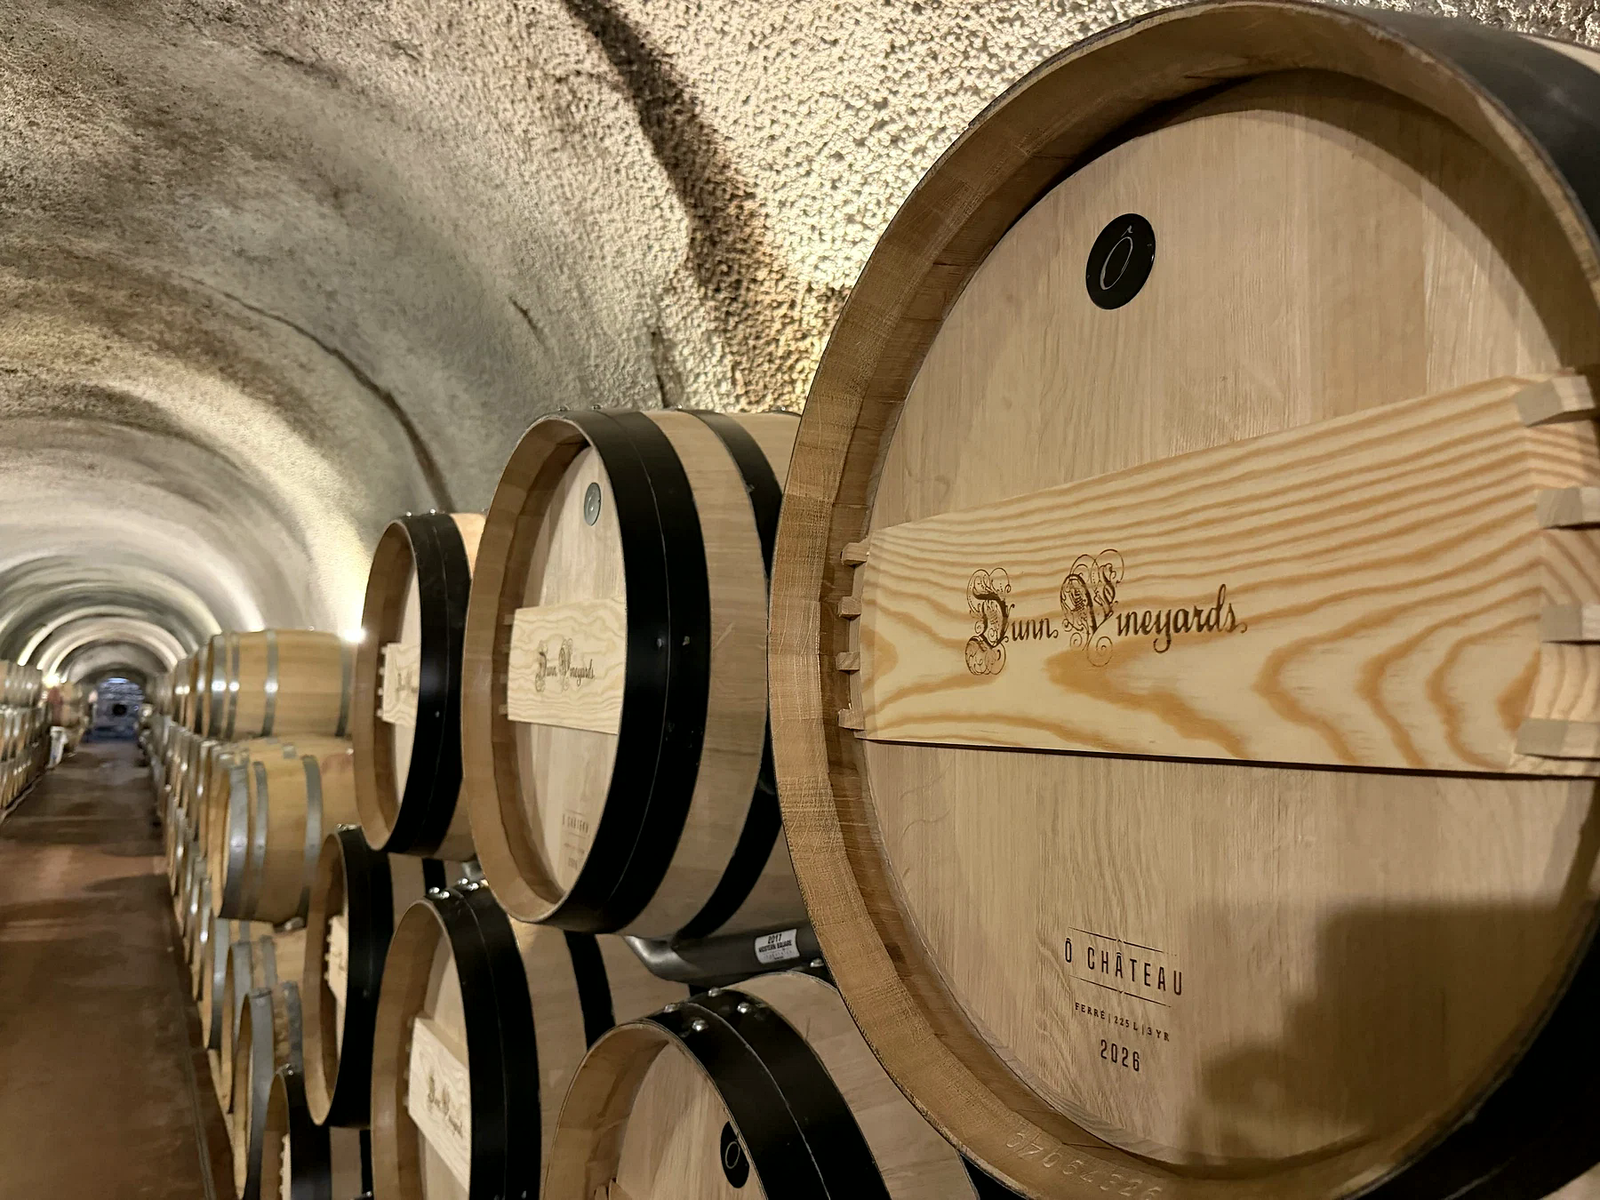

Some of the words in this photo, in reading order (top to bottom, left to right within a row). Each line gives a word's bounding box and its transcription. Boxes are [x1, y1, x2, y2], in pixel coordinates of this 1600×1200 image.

[964, 566, 1059, 676] Dunn
[1059, 548, 1248, 668] Vineyards
[1064, 937, 1073, 963] Ô
[1087, 946, 1182, 996] CHÂTEAU
[1113, 1015, 1130, 1028] 225
[1133, 1021, 1138, 1031] L
[1147, 1026, 1152, 1036] 3
[1155, 1029, 1170, 1042] YR
[1100, 1038, 1140, 1072] 2026
